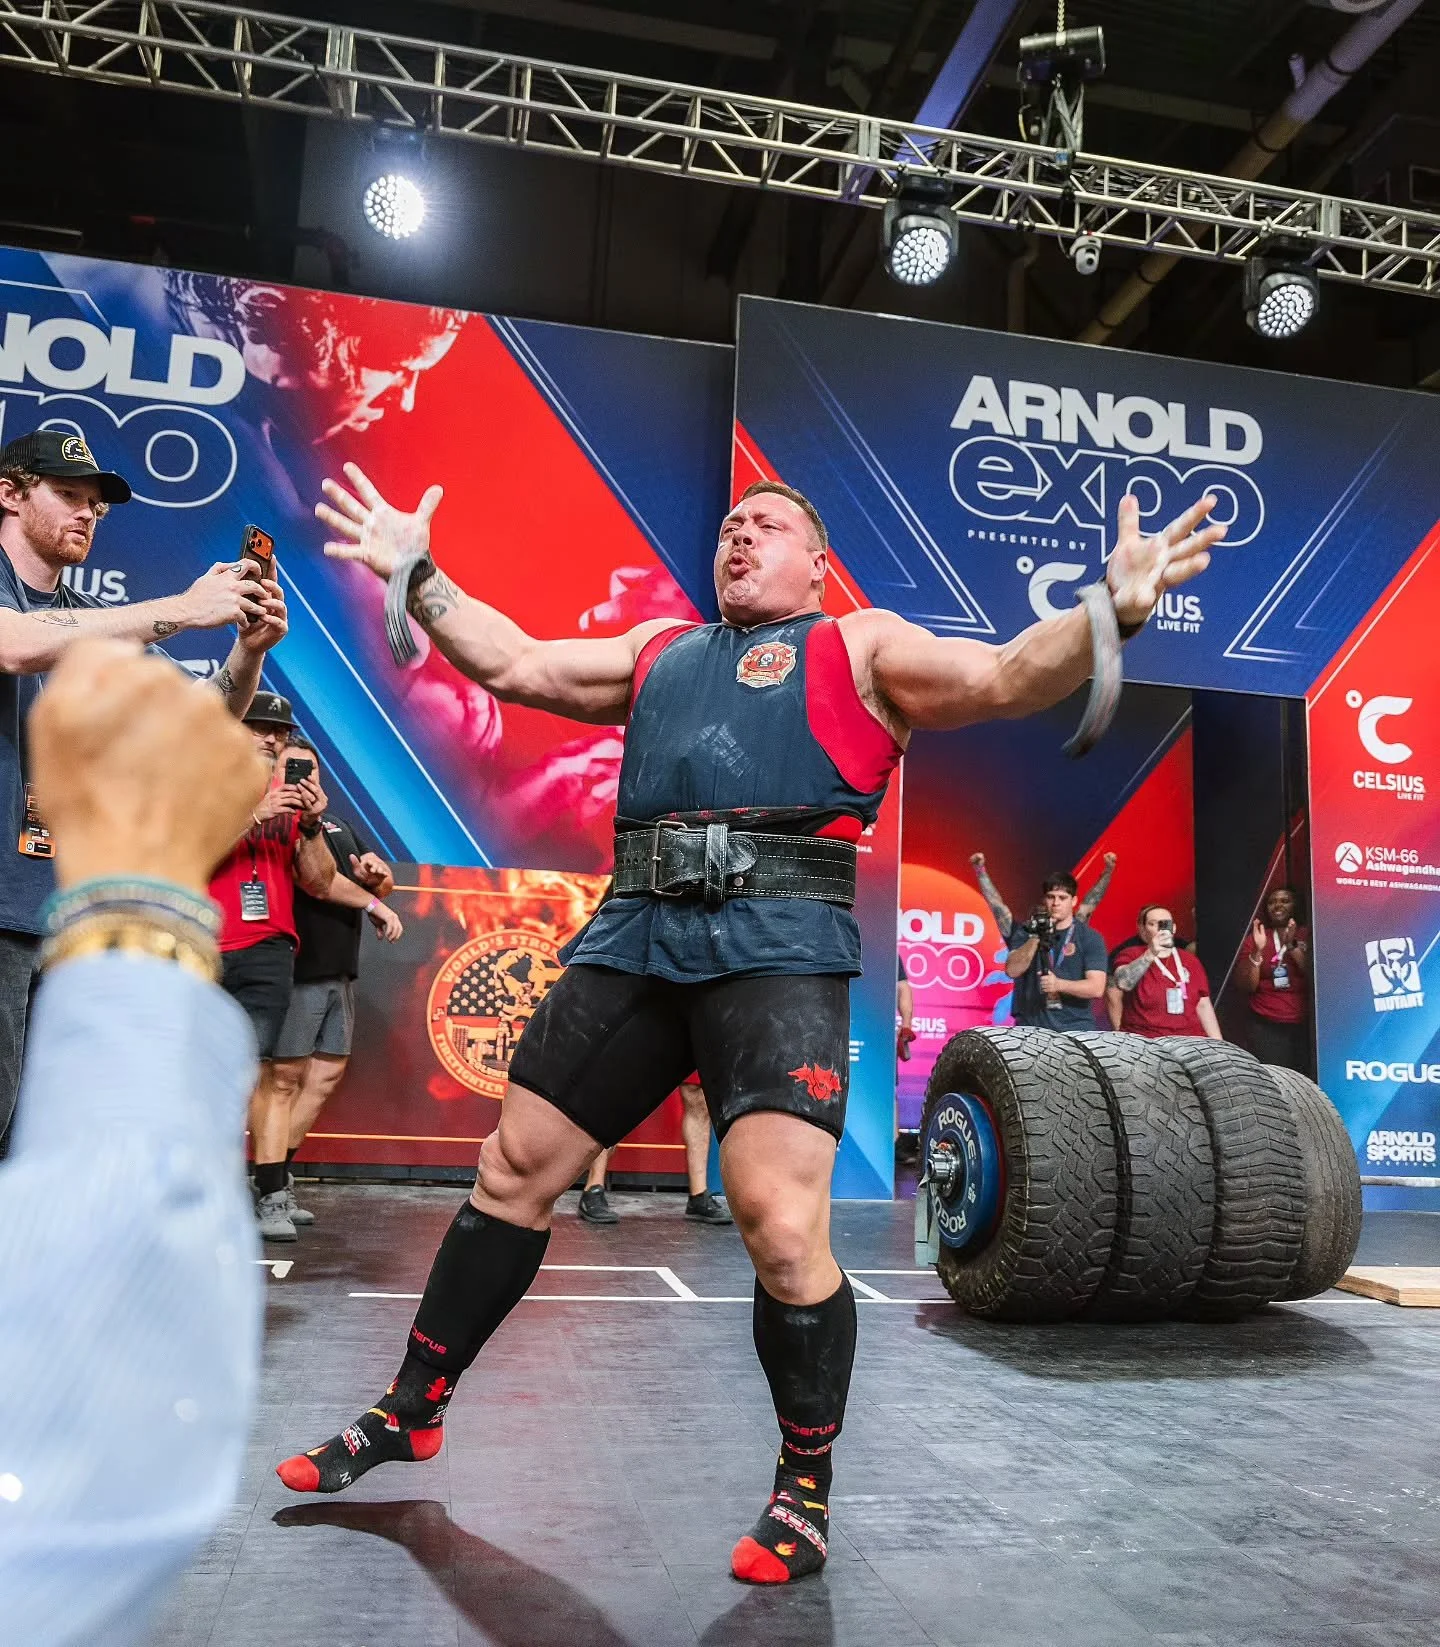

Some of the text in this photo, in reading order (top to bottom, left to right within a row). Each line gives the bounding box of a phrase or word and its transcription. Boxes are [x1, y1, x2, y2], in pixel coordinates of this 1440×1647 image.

[950, 375, 1263, 465] ARNOLD
[949, 435, 1265, 564] expo
[967, 529, 1087, 551] PRESENTED BY
[1157, 619, 1200, 633] LIVE FIT
[1353, 770, 1425, 793] CELSIUS
[1365, 846, 1419, 864] KSM-66
[898, 909, 984, 945] OLD
[441, 936, 505, 983] WORLD'S
[1373, 992, 1425, 1012] MUTANT
[435, 1033, 505, 1093] FIREFIGHTER
[1345, 1060, 1440, 1083] ROGUE
[937, 1106, 977, 1160] ROGUE
[1367, 1130, 1436, 1147] ARNOLD
[1367, 1145, 1437, 1163] SPORTS
